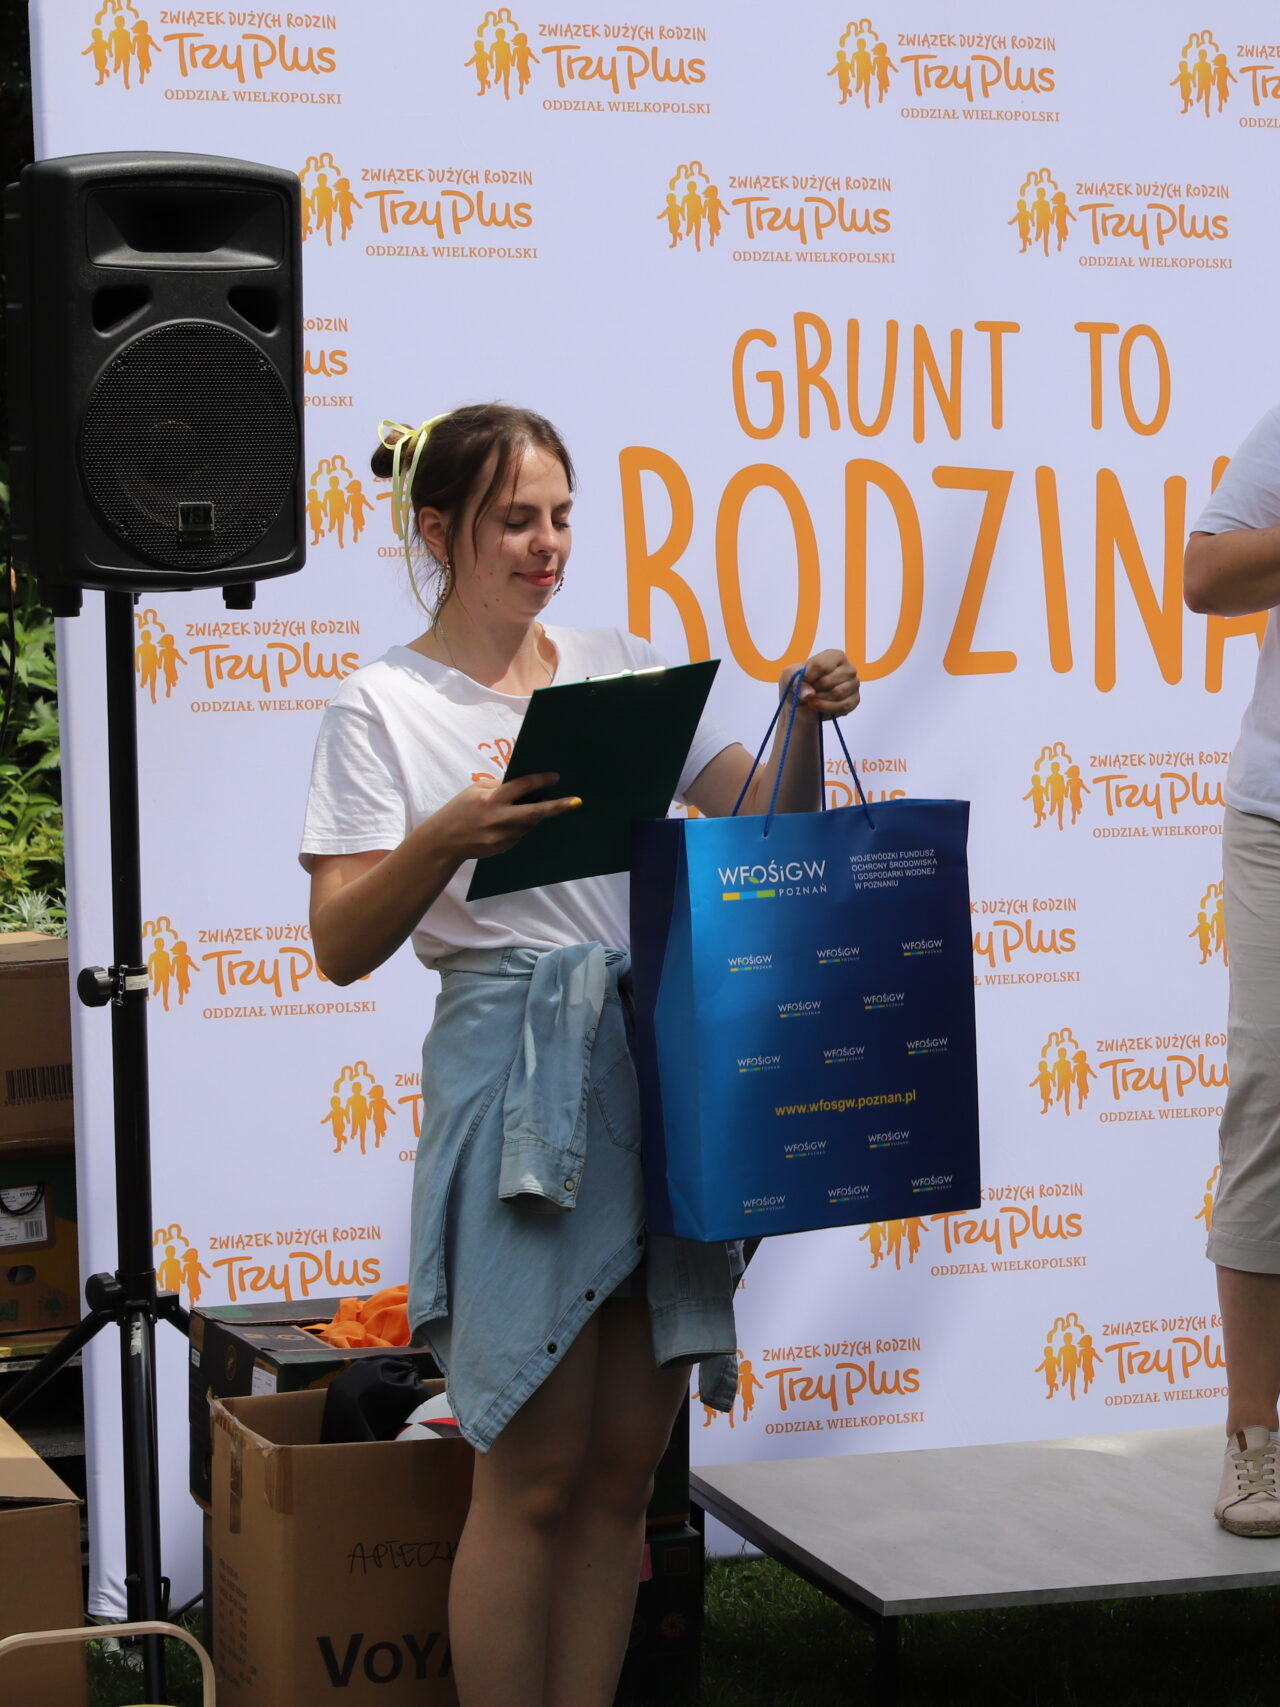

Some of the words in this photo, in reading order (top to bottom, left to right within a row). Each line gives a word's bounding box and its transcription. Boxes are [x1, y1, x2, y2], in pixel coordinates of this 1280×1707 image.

[160, 10, 226, 26] ZWIĄZEK
[228, 10, 284, 29] DUŻYCH
[286, 13, 337, 29] RODZIN
[538, 24, 603, 40] ZWIĄZEK
[603, 24, 655, 40] DUŻYCH
[658, 26, 707, 40] RODZIN
[897, 33, 957, 48] ZWIĄZEK
[959, 33, 1007, 50] DUŻYCH
[1011, 35, 1056, 50] RODZIN
[164, 89, 229, 102] ODDZIAŁ
[233, 91, 342, 104] WIELKOPOLSKI
[543, 100, 604, 112] ODDZIAŁ
[607, 101, 711, 114] WIELKOPOLSKI
[900, 108, 960, 120] ODDZIAŁ
[963, 109, 1060, 122] WIELKOPOLSKI
[361, 168, 426, 184] ZWIĄZEK
[427, 168, 481, 185] DUŻYCH
[484, 169, 533, 184] RODZIN
[728, 176, 790, 190] ZWIĄZEK
[791, 175, 841, 192] DUŻYCH
[845, 176, 892, 192] RODZIN
[1075, 183, 1133, 197] ZWIĄZEK
[1135, 183, 1182, 199] DUŻYCH
[1186, 184, 1230, 199] RODZIN
[365, 245, 430, 257] ODDZIAŁ
[432, 247, 538, 258] WIELKOPOLSKI
[732, 251, 792, 262] ODDZIAŁ
[796, 252, 896, 264] WIELKOPOLSKI
[1080, 256, 1136, 267] ODDZIAŁ
[1138, 257, 1232, 268] WIELKOPOLSKI
[731, 311, 1022, 444] GRUNT
[1073, 321, 1172, 436] TO
[184, 621, 251, 640] ZWIĄZEK
[251, 620, 308, 637] DUŻYCH
[310, 620, 362, 635] RODZIN
[190, 701, 256, 712] ODDZIAŁ
[257, 699, 330, 711] WIELKOP
[861, 758, 909, 772] RODZIN
[1089, 753, 1146, 768] ZWIĄZEK
[1148, 752, 1194, 768] DUŻYCH
[1198, 752, 1232, 764] RODZI
[1092, 827, 1149, 839] ODDZIAŁ
[1152, 824, 1222, 836] WIELKOPOL
[850, 852, 898, 863] WOJEWÓDZKI
[900, 849, 935, 859] FUNDUSZ
[852, 861, 887, 872] OCHRONY
[889, 857, 938, 869] ŚRODOWISKA
[857, 869, 904, 881] GOSPODARKI
[905, 868, 936, 877] WODNEJ
[779, 883, 827, 897] POZNAŃ
[854, 881, 863, 890] W
[863, 879, 899, 888] POZNANIU
[981, 899, 1029, 915] DUŻYCH
[1032, 898, 1078, 912] RODZIN
[198, 928, 263, 944] ZWIĄZEK
[265, 924, 314, 942] DUŻYC
[986, 971, 1080, 984] WIELKOPOLSKI
[201, 1006, 268, 1019] ODDZIAŁ
[269, 1000, 377, 1016] WIELKOPOLSKI
[1096, 1037, 1153, 1052] ZWIĄZEK
[1155, 1035, 1202, 1049] DUŻYCH
[775, 1089, 917, 1116] www.wfosgw.poznan.pl
[1100, 1111, 1155, 1122] ODDZIAŁ
[1159, 1106, 1225, 1122] WIELKOPO
[983, 1185, 1031, 1201] DUŻYCH
[1034, 1184, 1084, 1199] RODZIN
[209, 1233, 274, 1251] ZWIĄZEK
[275, 1229, 329, 1246] DUŻYCH
[332, 1226, 382, 1243] RODZIN
[930, 1264, 987, 1276] ODDZIAŁ
[992, 1256, 1088, 1272] WIELKOPOLSKI
[1102, 1320, 1158, 1336] ZWIĄZEK
[1160, 1317, 1207, 1332] DUŻYCH
[762, 1344, 822, 1362] ZWIĄZEK
[824, 1342, 873, 1357] DUŻYCH
[876, 1338, 921, 1352] RODZIN
[1104, 1392, 1161, 1406] ODDZIAŁ
[1163, 1385, 1228, 1400] WIELKOPO
[765, 1421, 823, 1434] ODDZIAŁ
[827, 1412, 925, 1428] WIELKOPOLSKI
